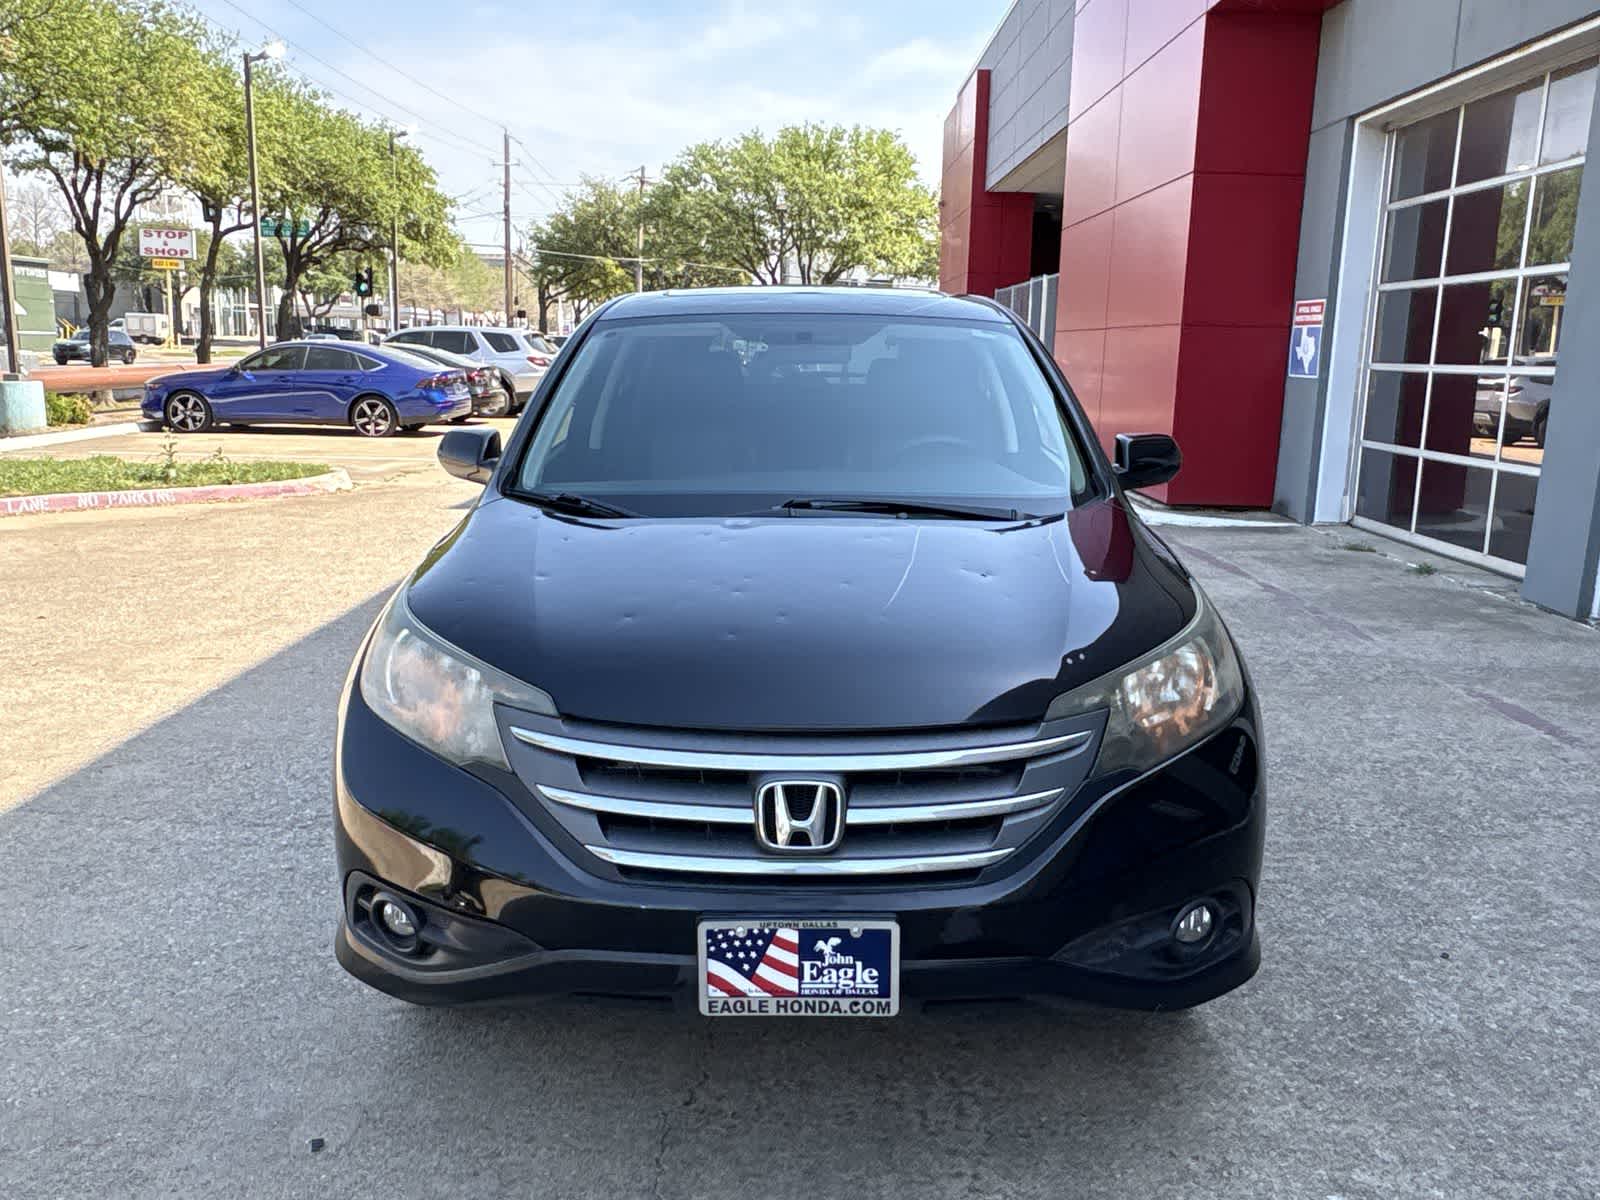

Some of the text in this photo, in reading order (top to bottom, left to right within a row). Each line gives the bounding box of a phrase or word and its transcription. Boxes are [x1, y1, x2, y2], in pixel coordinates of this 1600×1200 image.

[143, 229, 188, 239] STOP
[143, 247, 189, 256] SHOP
[6, 490, 176, 512] LANE NO PARKING
[822, 952, 854, 967] John
[801, 960, 879, 989] Eagle
[707, 1000, 891, 1014] EAGLE HONDA.COM
